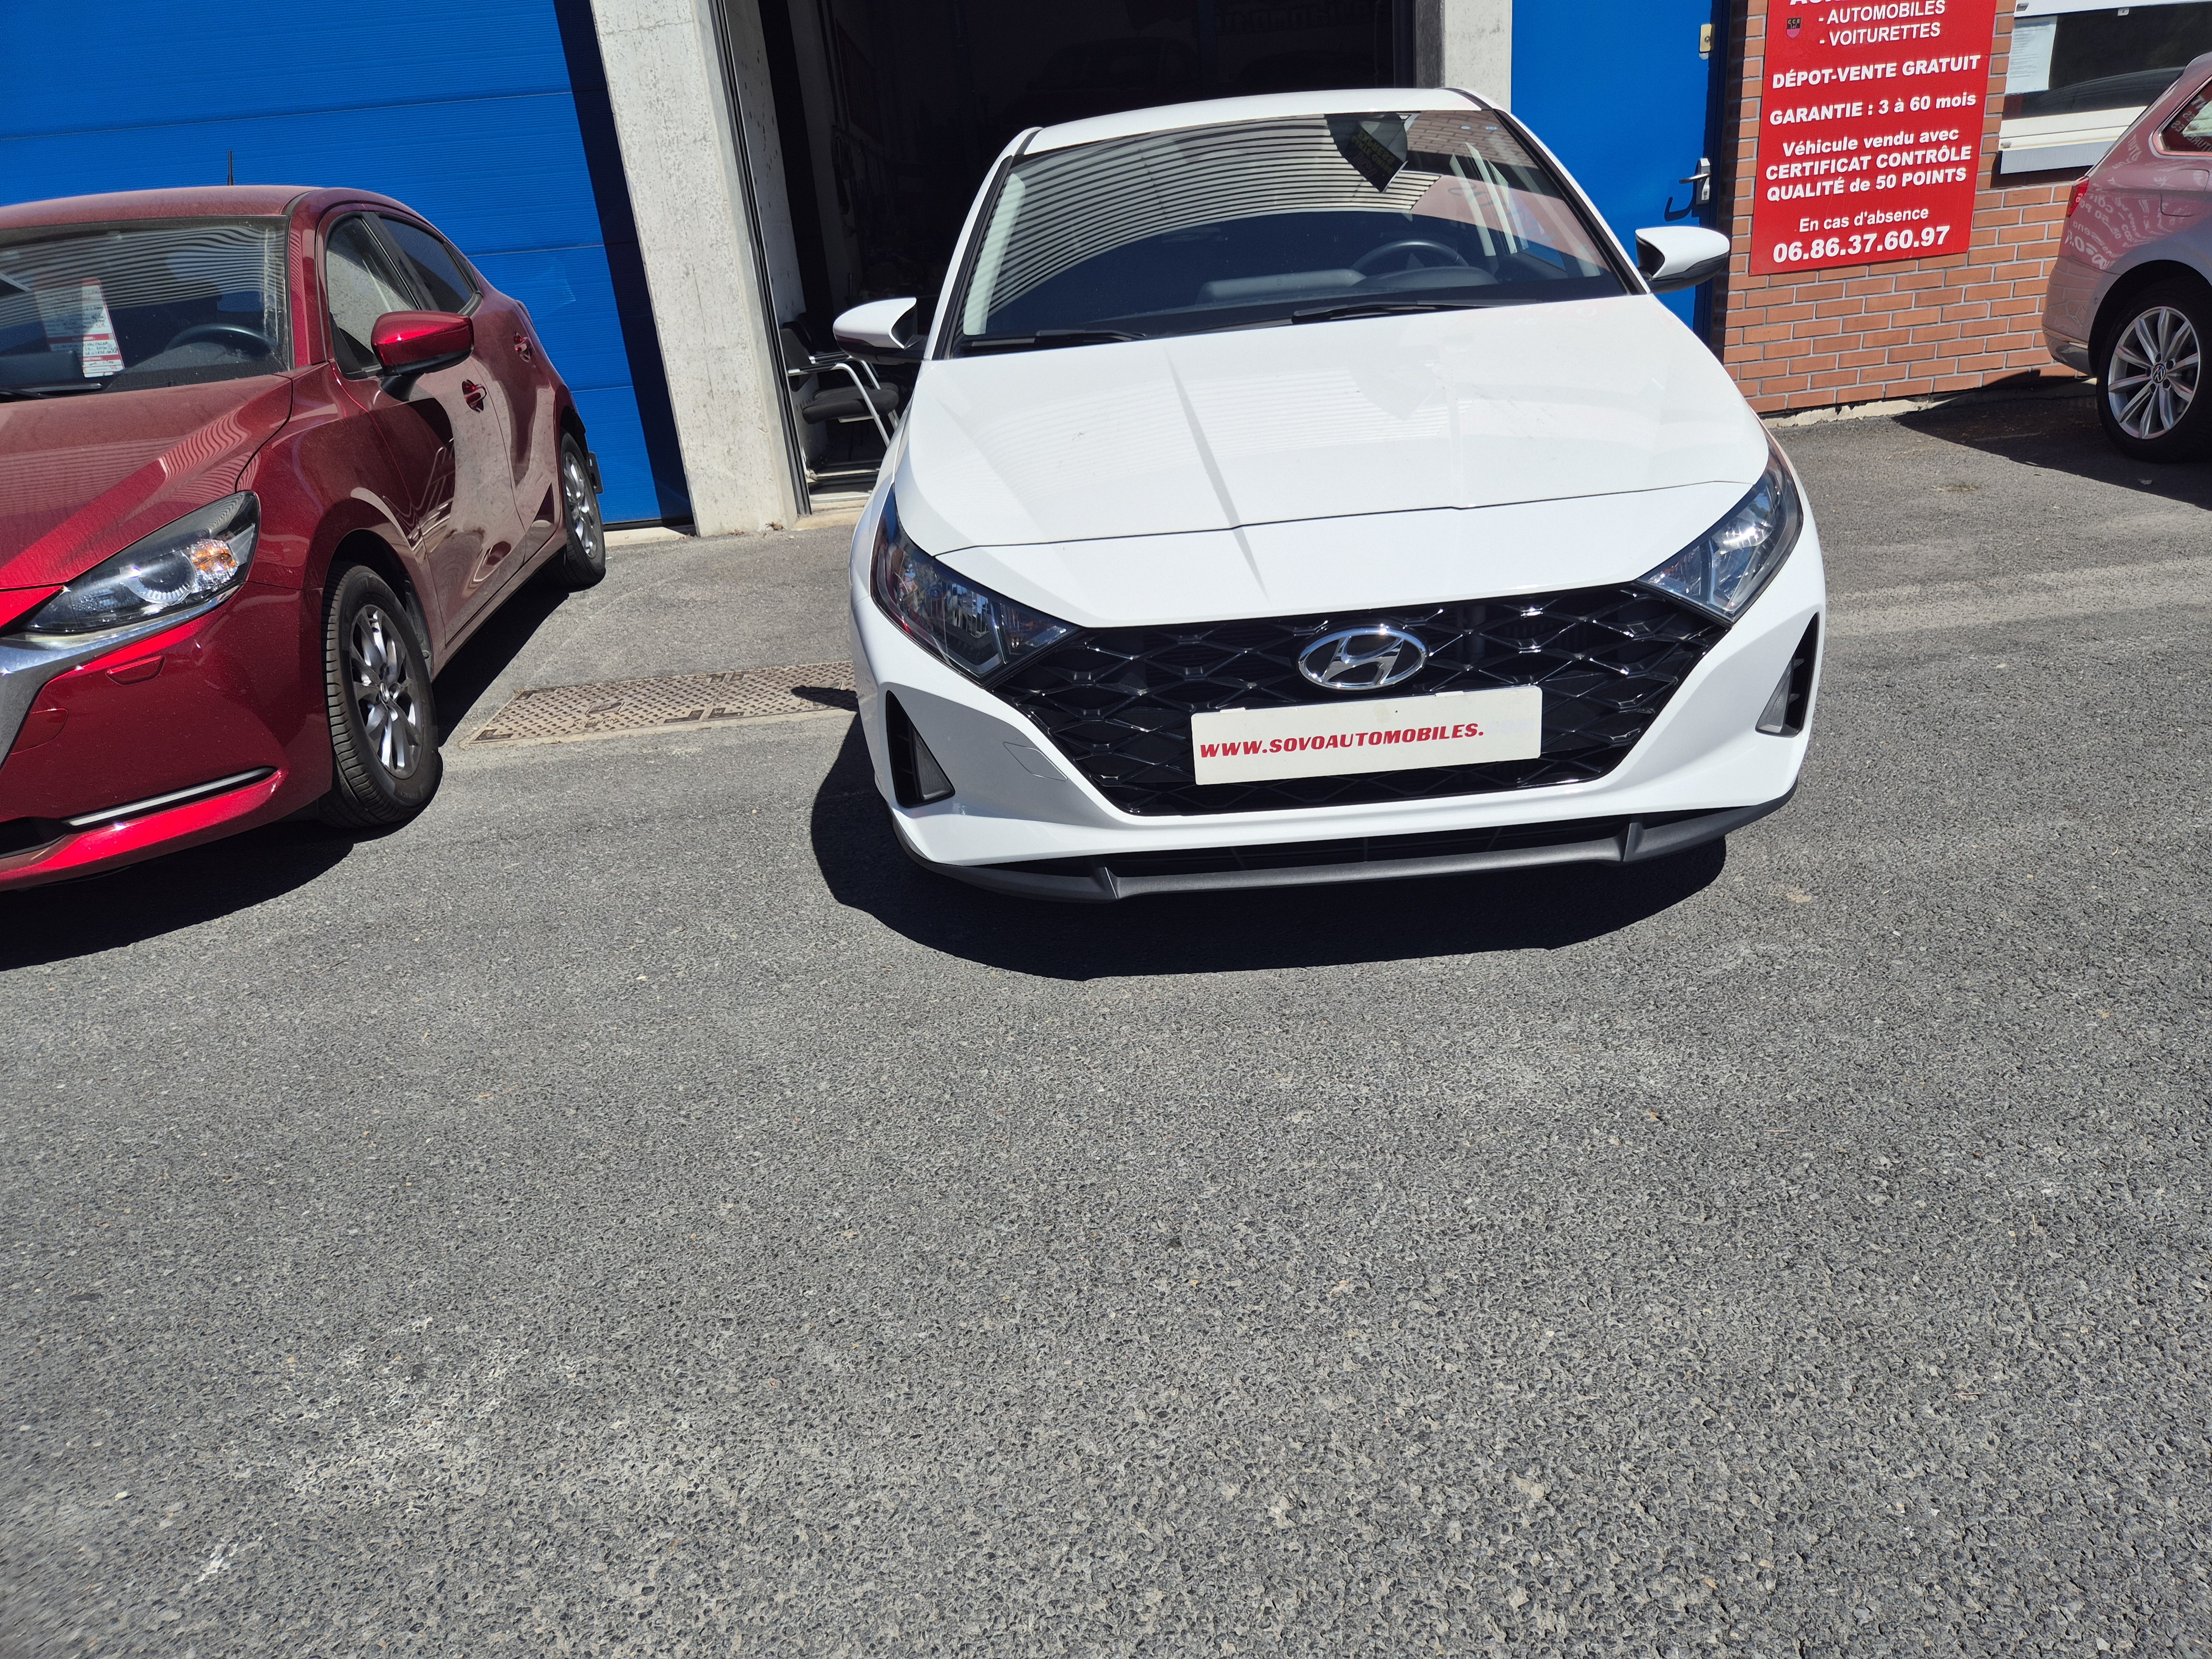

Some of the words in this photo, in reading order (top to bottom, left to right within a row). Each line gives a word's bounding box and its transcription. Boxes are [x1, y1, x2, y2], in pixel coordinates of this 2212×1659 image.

[1827, 0, 1946, 25] AUTOMOBILES
[1829, 22, 1940, 46] VOITURETTES
[1772, 62, 1897, 89] DÉPOT-VENTE
[1902, 54, 1981, 76] GRATUIT
[1770, 101, 1863, 125] GARANTIE
[1878, 99, 1889, 114] 3
[1893, 97, 1905, 113] à
[1910, 95, 1931, 111] 60
[1936, 91, 1976, 109] mois
[1782, 136, 1858, 157] Véhicule
[1863, 131, 1914, 149] vendu
[1919, 129, 1959, 143] avec
[1766, 155, 1872, 180] CERTIFICAT
[1876, 144, 1972, 169] CONTRÔLE
[1767, 176, 1845, 202] QUALITÉ
[1849, 178, 1871, 192] de
[1875, 174, 1897, 190] 50
[1901, 167, 1966, 187] POINTS
[1799, 217, 1819, 232] En
[1823, 217, 1849, 230] cas
[1854, 208, 1929, 226] d'absence
[1773, 225, 1950, 263] 06.86.37.60.97
